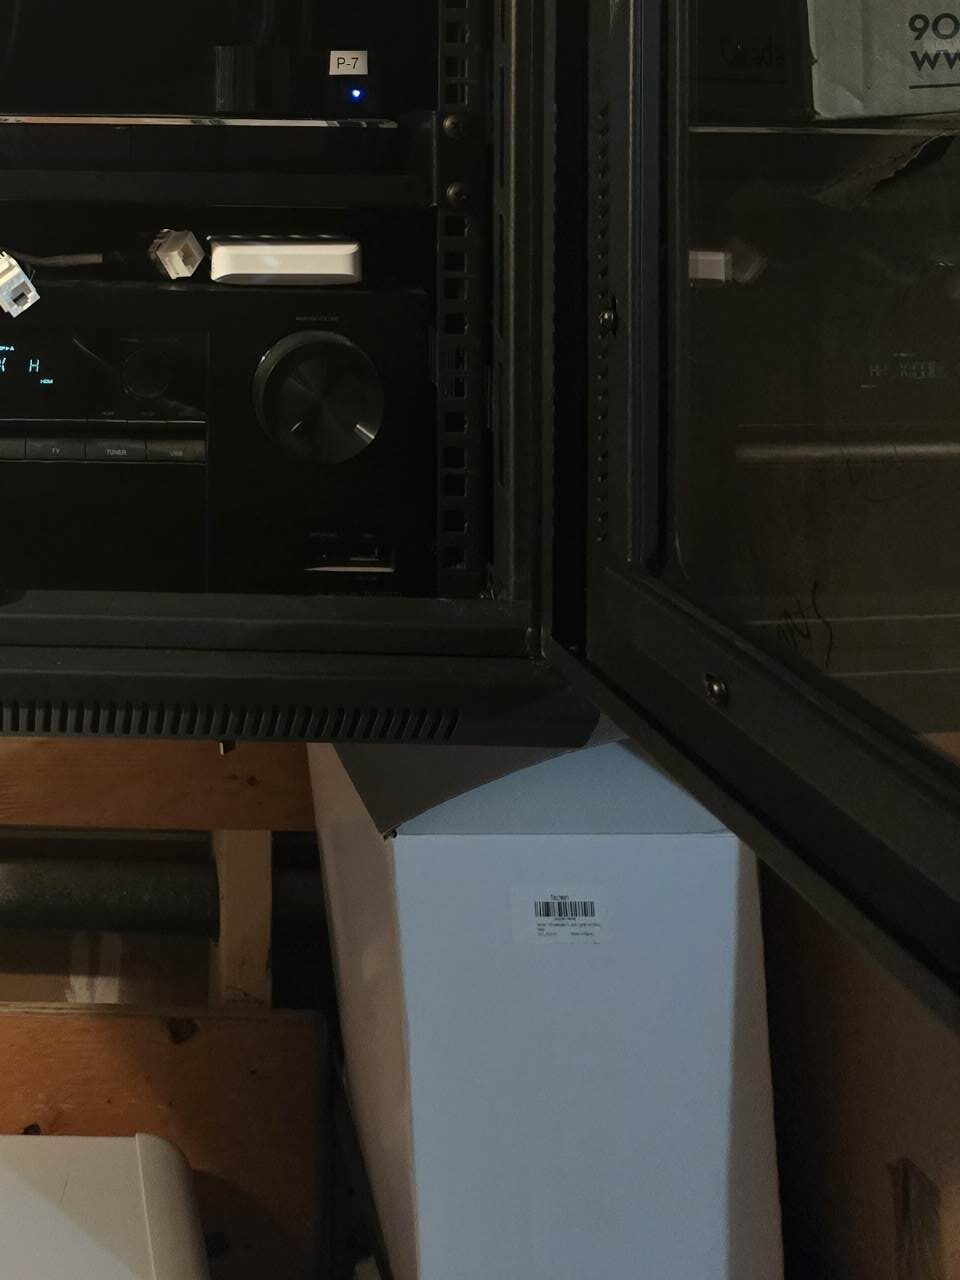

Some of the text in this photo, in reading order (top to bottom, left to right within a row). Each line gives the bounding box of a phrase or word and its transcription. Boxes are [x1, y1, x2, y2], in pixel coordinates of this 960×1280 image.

[337, 57, 359, 69] P-7
[28, 359, 40, 373] H
[106, 448, 127, 456] TUNER
